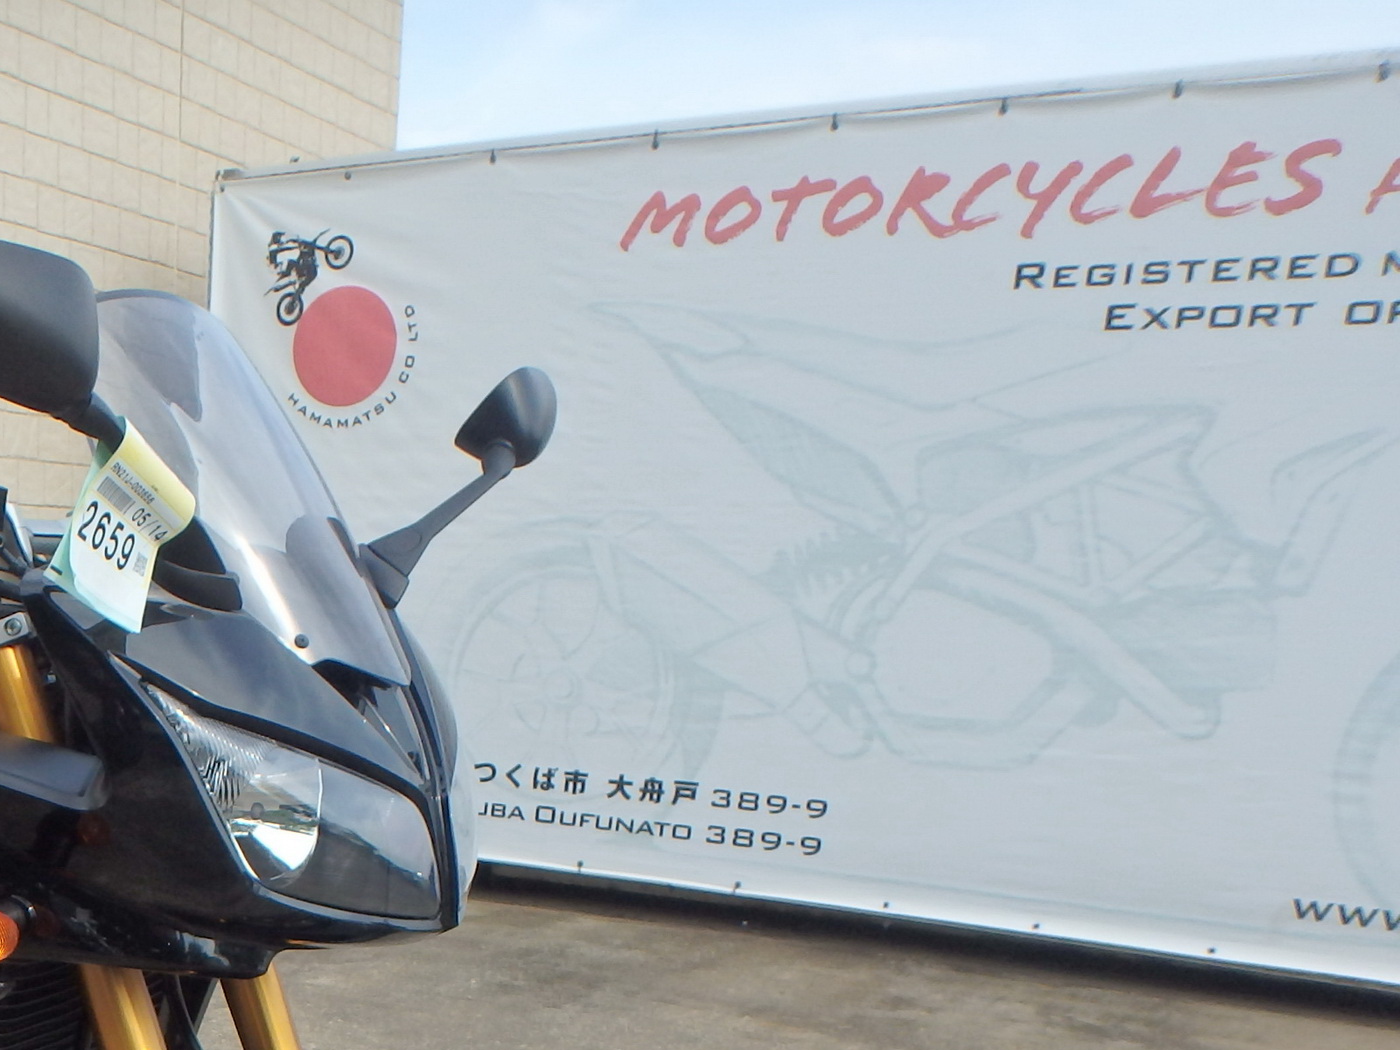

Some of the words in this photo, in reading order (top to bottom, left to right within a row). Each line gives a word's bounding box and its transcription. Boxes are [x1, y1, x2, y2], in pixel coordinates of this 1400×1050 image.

[620, 139, 1341, 250] MOTORCYCLES
[1013, 252, 1362, 289] REGISTERED
[404, 305, 419, 342] LTD
[1103, 302, 1316, 331] EXPORT
[398, 355, 415, 384] CO
[287, 391, 397, 429] HAMAMATSU
[76, 500, 137, 571] 2659
[131, 506, 169, 542] 05/14
[606, 774, 700, 805] 大舟戸
[711, 788, 829, 819] 389-9
[534, 804, 692, 841] OUFUNATO
[705, 824, 822, 856] 389-9
